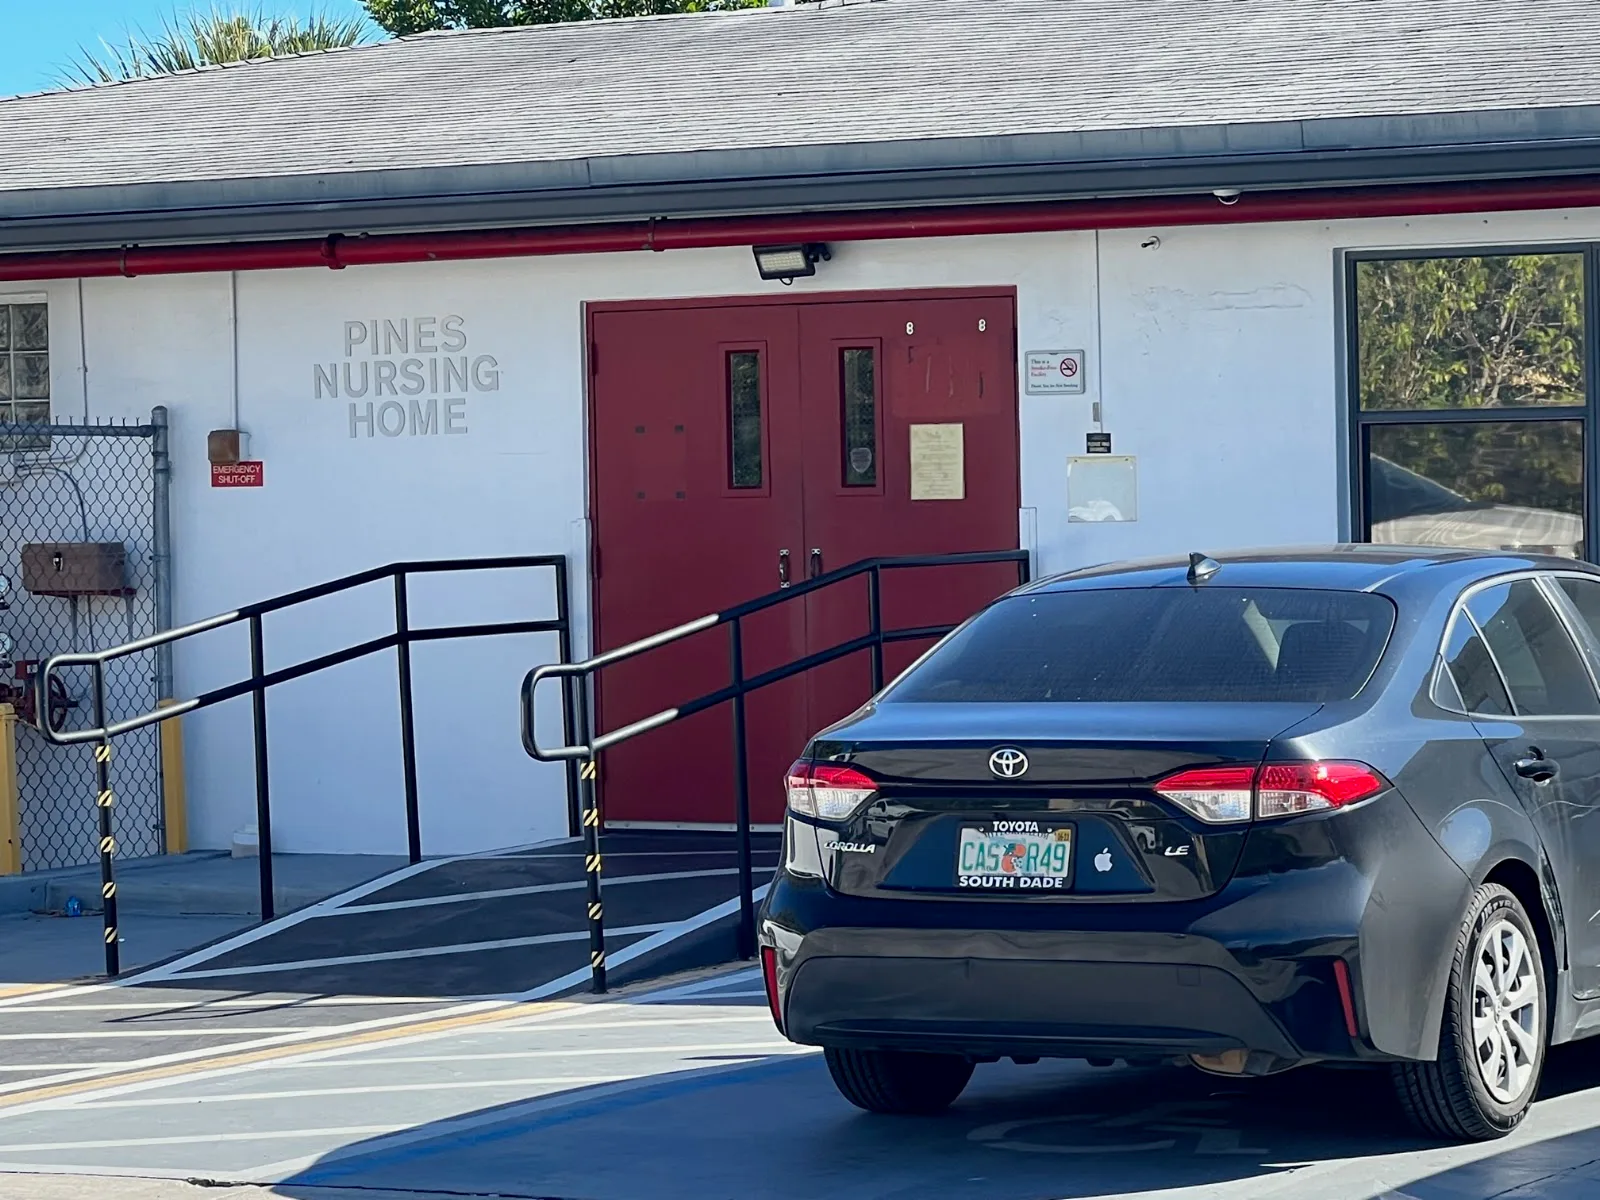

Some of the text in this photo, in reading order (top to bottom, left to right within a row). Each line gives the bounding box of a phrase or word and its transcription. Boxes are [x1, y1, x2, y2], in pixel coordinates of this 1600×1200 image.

[344, 314, 467, 357] PINES
[313, 354, 500, 399] NURSING
[349, 398, 468, 438] HOME
[213, 465, 260, 474] EMERGENCY
[218, 475, 256, 484] SHUT-OFF
[993, 821, 1039, 832] TOYOTA
[824, 841, 876, 854] COROLLA
[1164, 845, 1190, 856] LE
[959, 875, 1063, 889] SOUTH DADE
